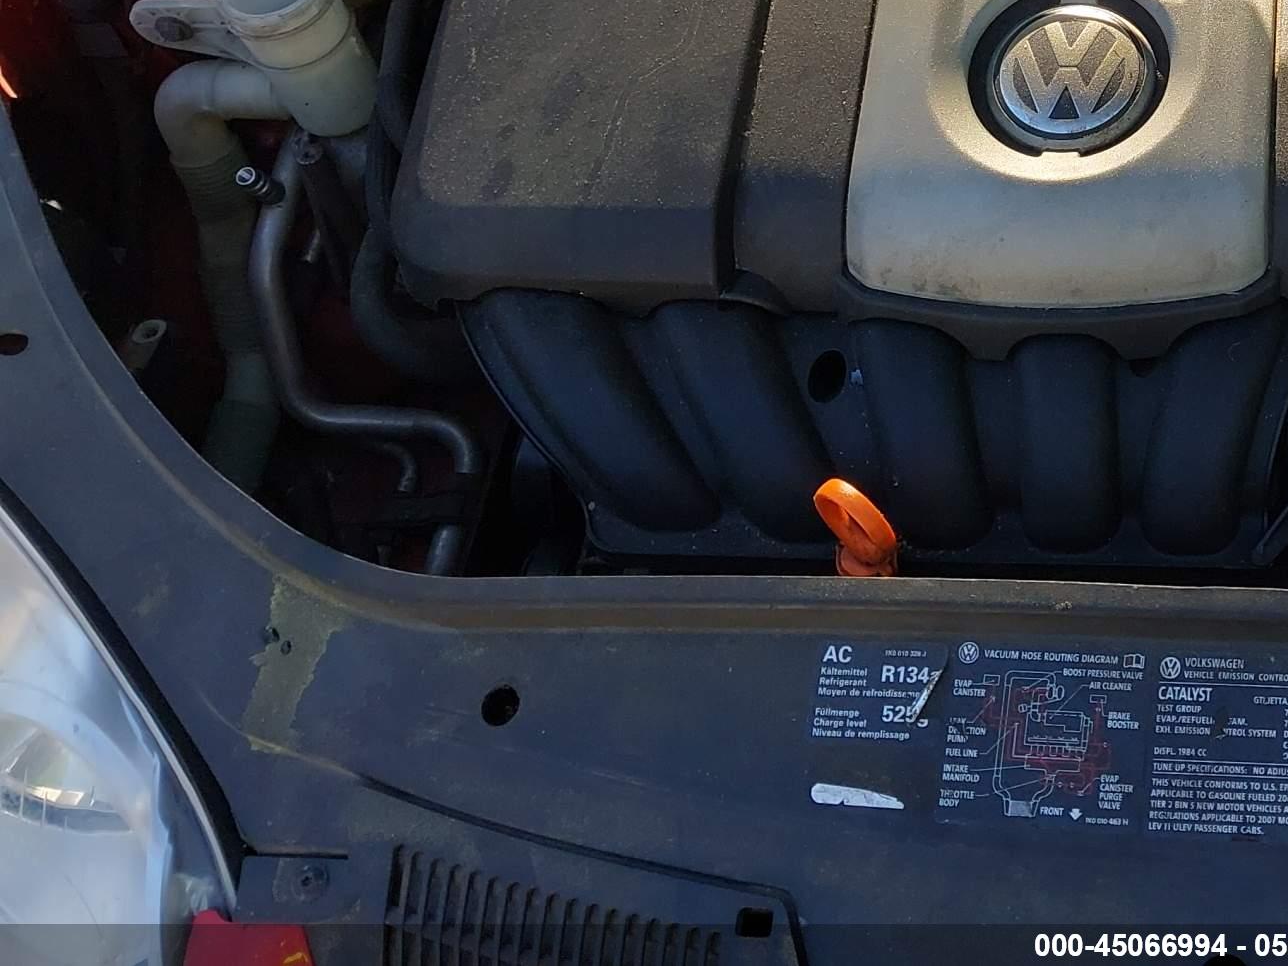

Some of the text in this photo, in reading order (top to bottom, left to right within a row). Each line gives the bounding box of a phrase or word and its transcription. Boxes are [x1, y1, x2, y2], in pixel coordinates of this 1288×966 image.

[823, 646, 852, 663] AC
[985, 649, 1118, 664] VACUUM HOSE ROUTING DIAGRAM
[1184, 658, 1244, 669] VOLKSWAGEN
[820, 667, 868, 676] Kältemittel
[1063, 668, 1143, 679] BOOST PRESSURE VALVE
[1184, 670, 1214, 679] VEHICLE
[1218, 672, 1254, 681] EMISSION
[819, 677, 867, 687] Refrigerant
[954, 679, 972, 687] EVAP
[1089, 681, 1132, 691] AIR CLEANER
[818, 687, 847, 696] Moyen
[849, 688, 861, 696] de
[953, 688, 986, 697] CANISTER
[1158, 686, 1213, 701] CATALYST
[815, 707, 860, 718] Füllmenge
[1157, 704, 1202, 713] TEST GROUP
[1108, 712, 1131, 720] BRAKE
[813, 718, 867, 729] Charge level
[1107, 720, 1139, 729] BOOSTER
[812, 728, 910, 741] Niveau de remplissage
[1174, 726, 1211, 735] EMISSION
[1248, 729, 1276, 738] SYSTEM
[946, 748, 978, 758] FUEL LINE
[944, 764, 968, 773] INTAKE
[1153, 762, 1172, 771] TUNE
[1174, 763, 1185, 771] UP
[1253, 767, 1265, 775] NO
[942, 773, 980, 782] MANIFOLD
[1101, 775, 1119, 783] EVAP
[1099, 784, 1133, 793] CANISTER
[1152, 778, 1169, 786] THIS
[1171, 779, 1202, 788] VEHICLE
[1204, 780, 1248, 789] CONFORMS
[1250, 782, 1260, 790] TO
[940, 789, 975, 799] THROTTLE
[1099, 793, 1123, 801] PURGE
[1150, 789, 1194, 798] APPLICABLE
[1196, 791, 1206, 799] TO
[1208, 791, 1245, 800] GASOLINE
[1248, 793, 1275, 802] FUELED
[939, 798, 959, 807] BODY
[1098, 801, 1120, 810] VALVE
[1150, 800, 1166, 808] TIER
[1174, 801, 1188, 809] BIN
[1196, 802, 1215, 810] NEW
[1217, 803, 1244, 811] MOTOR
[1246, 804, 1281, 813] VEHICLES
[1040, 807, 1064, 816] FRONT
[1149, 811, 1199, 821] REGULATIONS
[1201, 813, 1244, 822] APPLICABLE
[1246, 815, 1256, 823] TO
[1257, 815, 1276, 824] 2007
[1148, 822, 1161, 830] LEV
[1173, 823, 1192, 831] ULEV
[1194, 824, 1238, 833] PASSENGER
